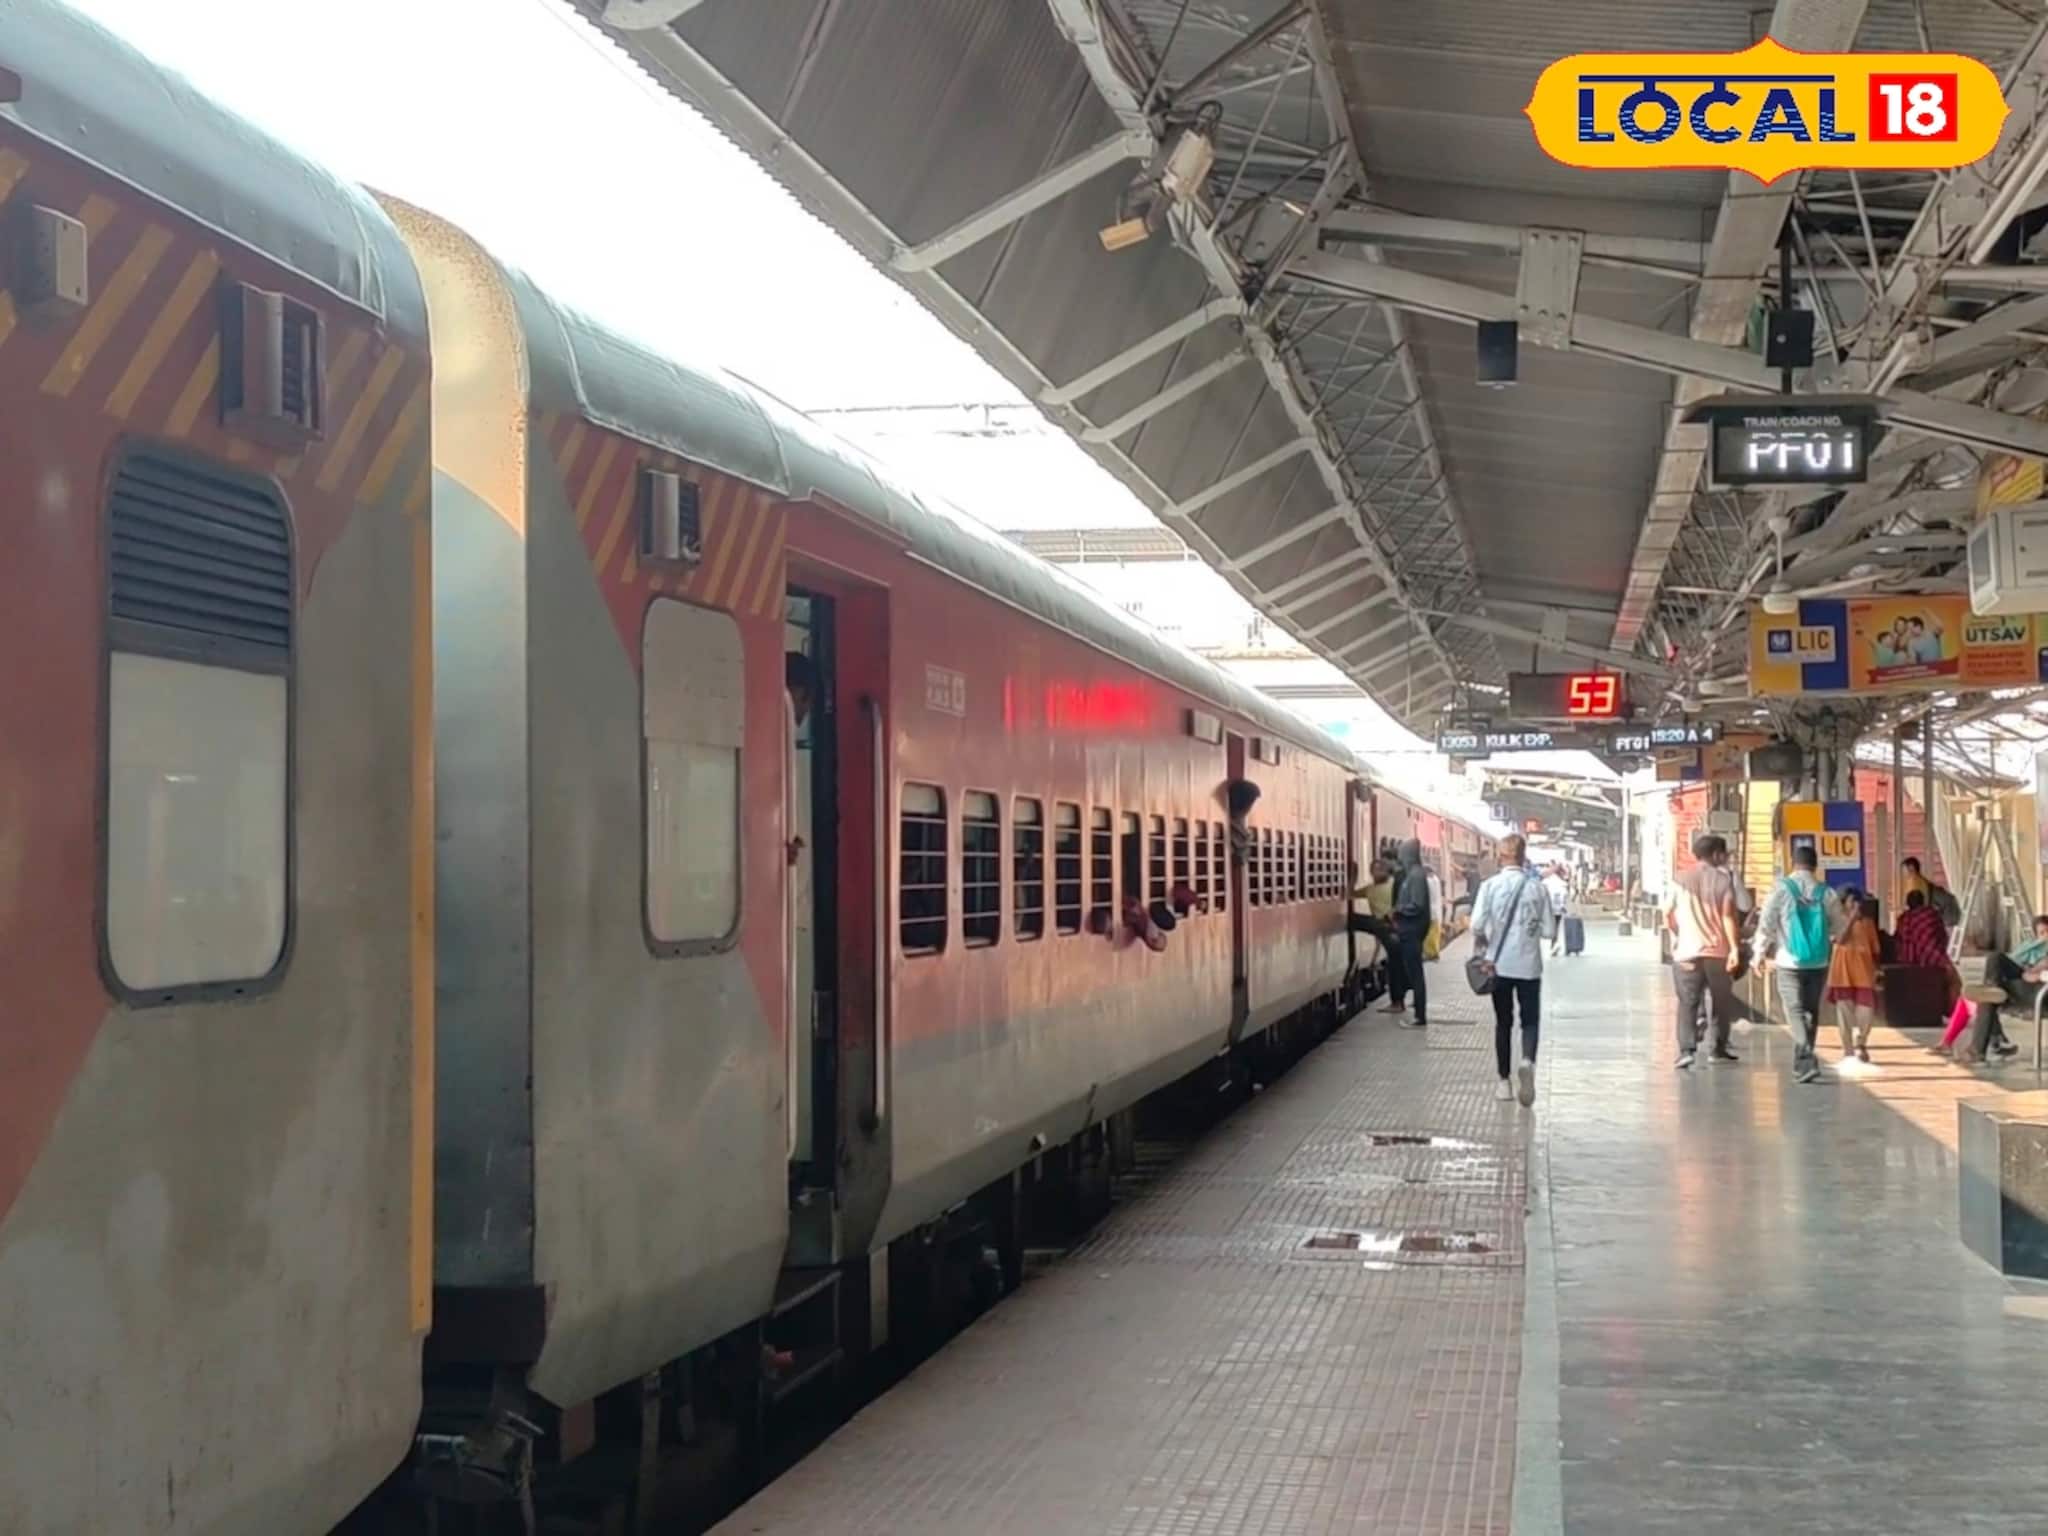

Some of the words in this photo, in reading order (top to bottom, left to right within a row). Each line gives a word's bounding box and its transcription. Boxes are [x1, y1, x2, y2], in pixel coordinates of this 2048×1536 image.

[1748, 432, 1854, 470] PF01
[1797, 630, 1830, 650] LIC
[1966, 626, 2026, 642] UTSAV
[1569, 677, 1615, 713] 53
[1688, 729, 1698, 742] A
[1821, 835, 1854, 857] LIC
